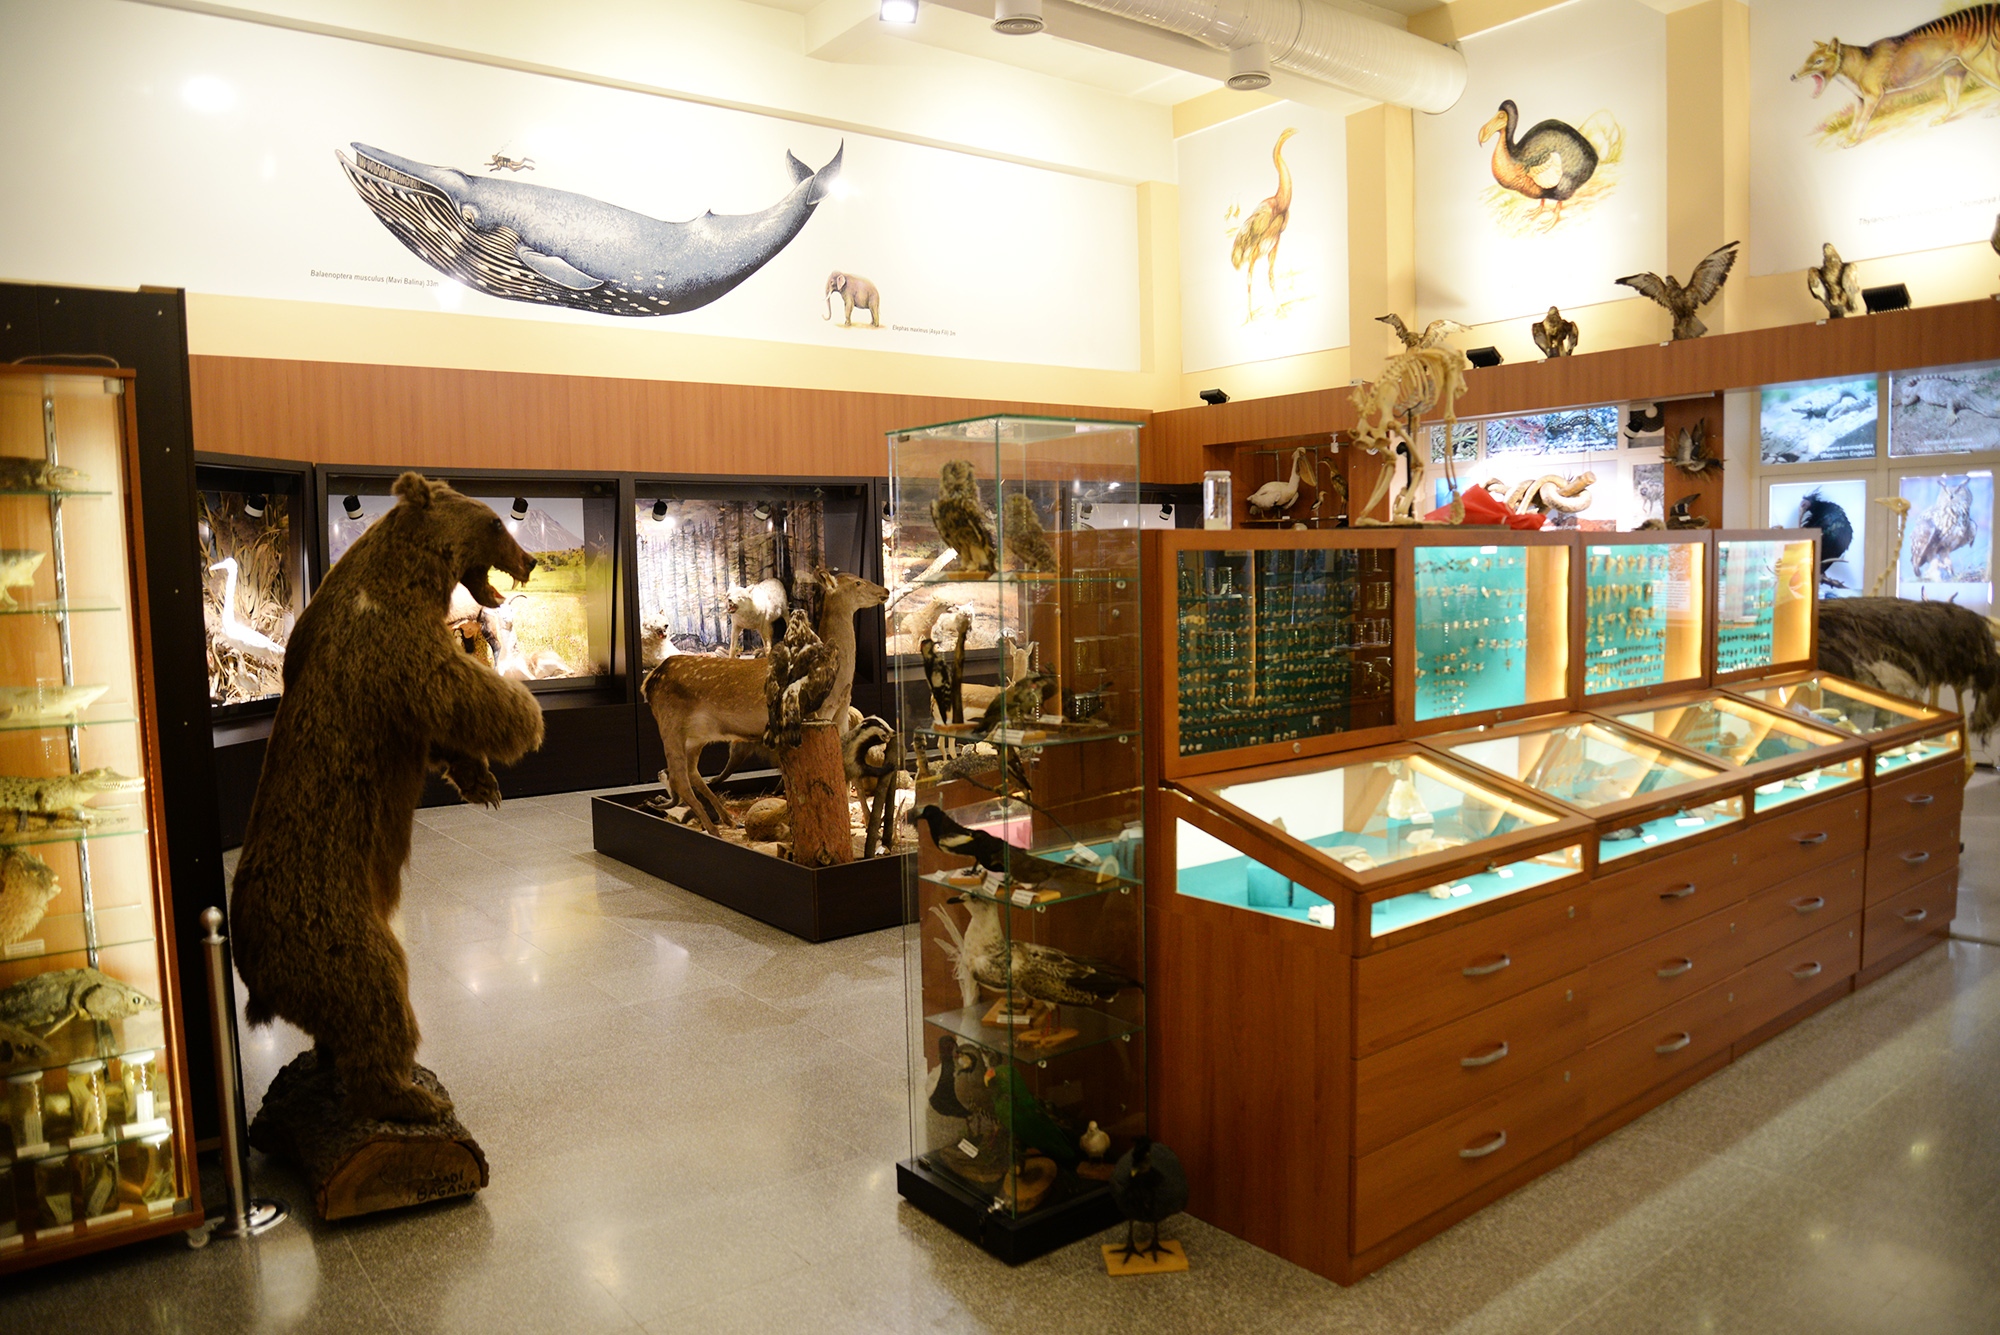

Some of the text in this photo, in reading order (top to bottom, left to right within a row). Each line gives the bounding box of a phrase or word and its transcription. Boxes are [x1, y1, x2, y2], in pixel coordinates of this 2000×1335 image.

[310, 269, 439, 288] Balaenoptera musculus (Mavi Balina) 33m
[892, 324, 909, 332] Elephas
[910, 326, 929, 334] maximus
